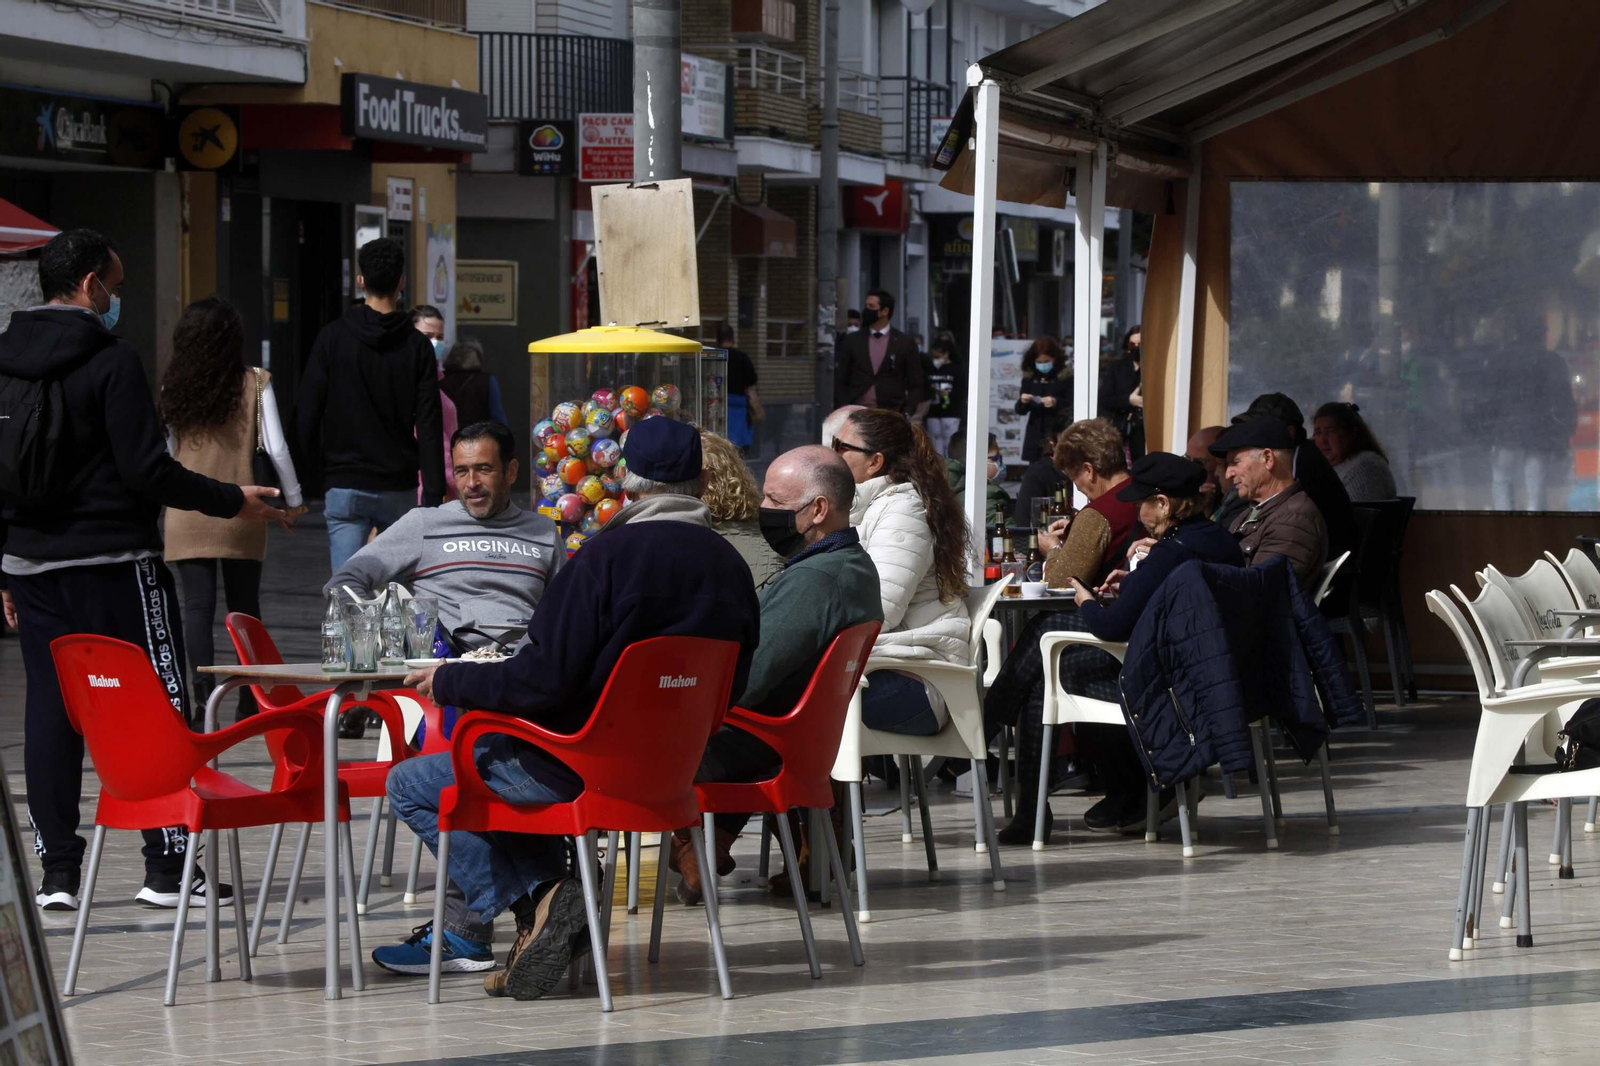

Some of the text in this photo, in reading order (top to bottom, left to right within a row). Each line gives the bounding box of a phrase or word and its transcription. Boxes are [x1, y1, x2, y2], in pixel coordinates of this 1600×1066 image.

[358, 82, 400, 132] Food
[403, 90, 460, 140] Trucks
[582, 117, 634, 126] PACO CAM
[443, 540, 542, 559] ORIGINALS
[150, 589, 166, 640] adidas
[159, 643, 179, 694] adidas
[87, 674, 121, 688] Mahou
[659, 674, 698, 689] Mahou
